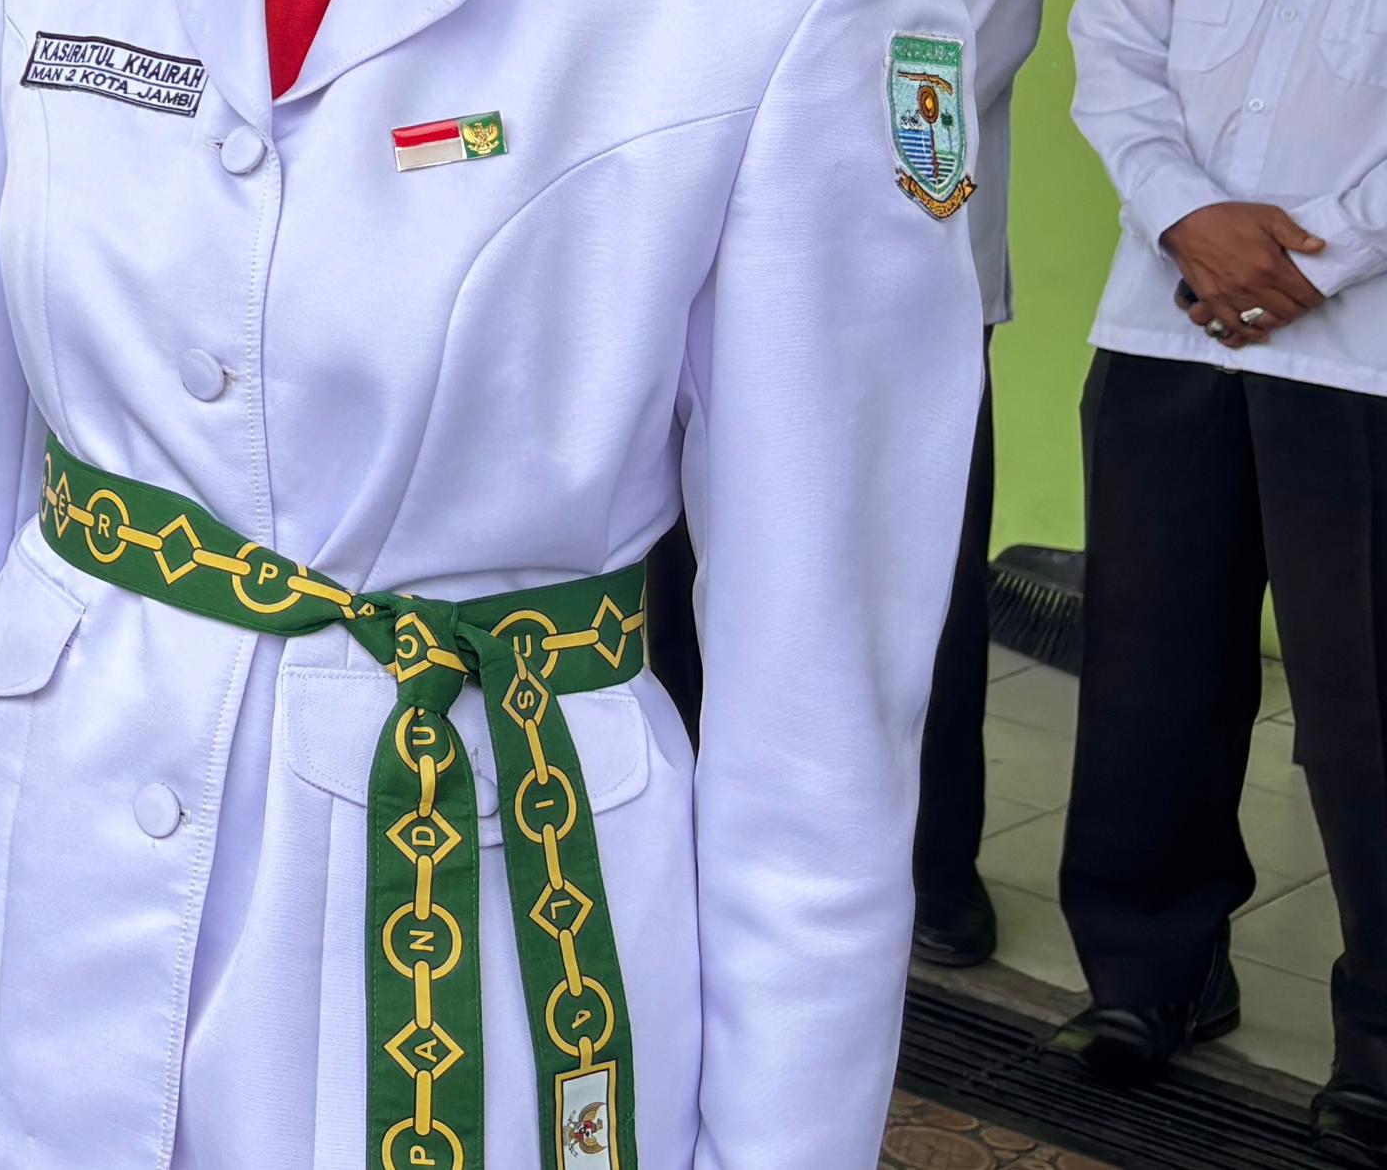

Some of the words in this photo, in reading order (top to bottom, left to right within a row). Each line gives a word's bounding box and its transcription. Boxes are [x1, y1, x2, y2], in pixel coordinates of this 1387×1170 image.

[31, 66, 63, 81] MAN
[65, 69, 75, 82] 2
[80, 70, 127, 94] KOTA
[137, 87, 195, 108] JAMBI
[39, 40, 116, 69] KASIRATUL
[121, 53, 205, 89] KHAIRAH
